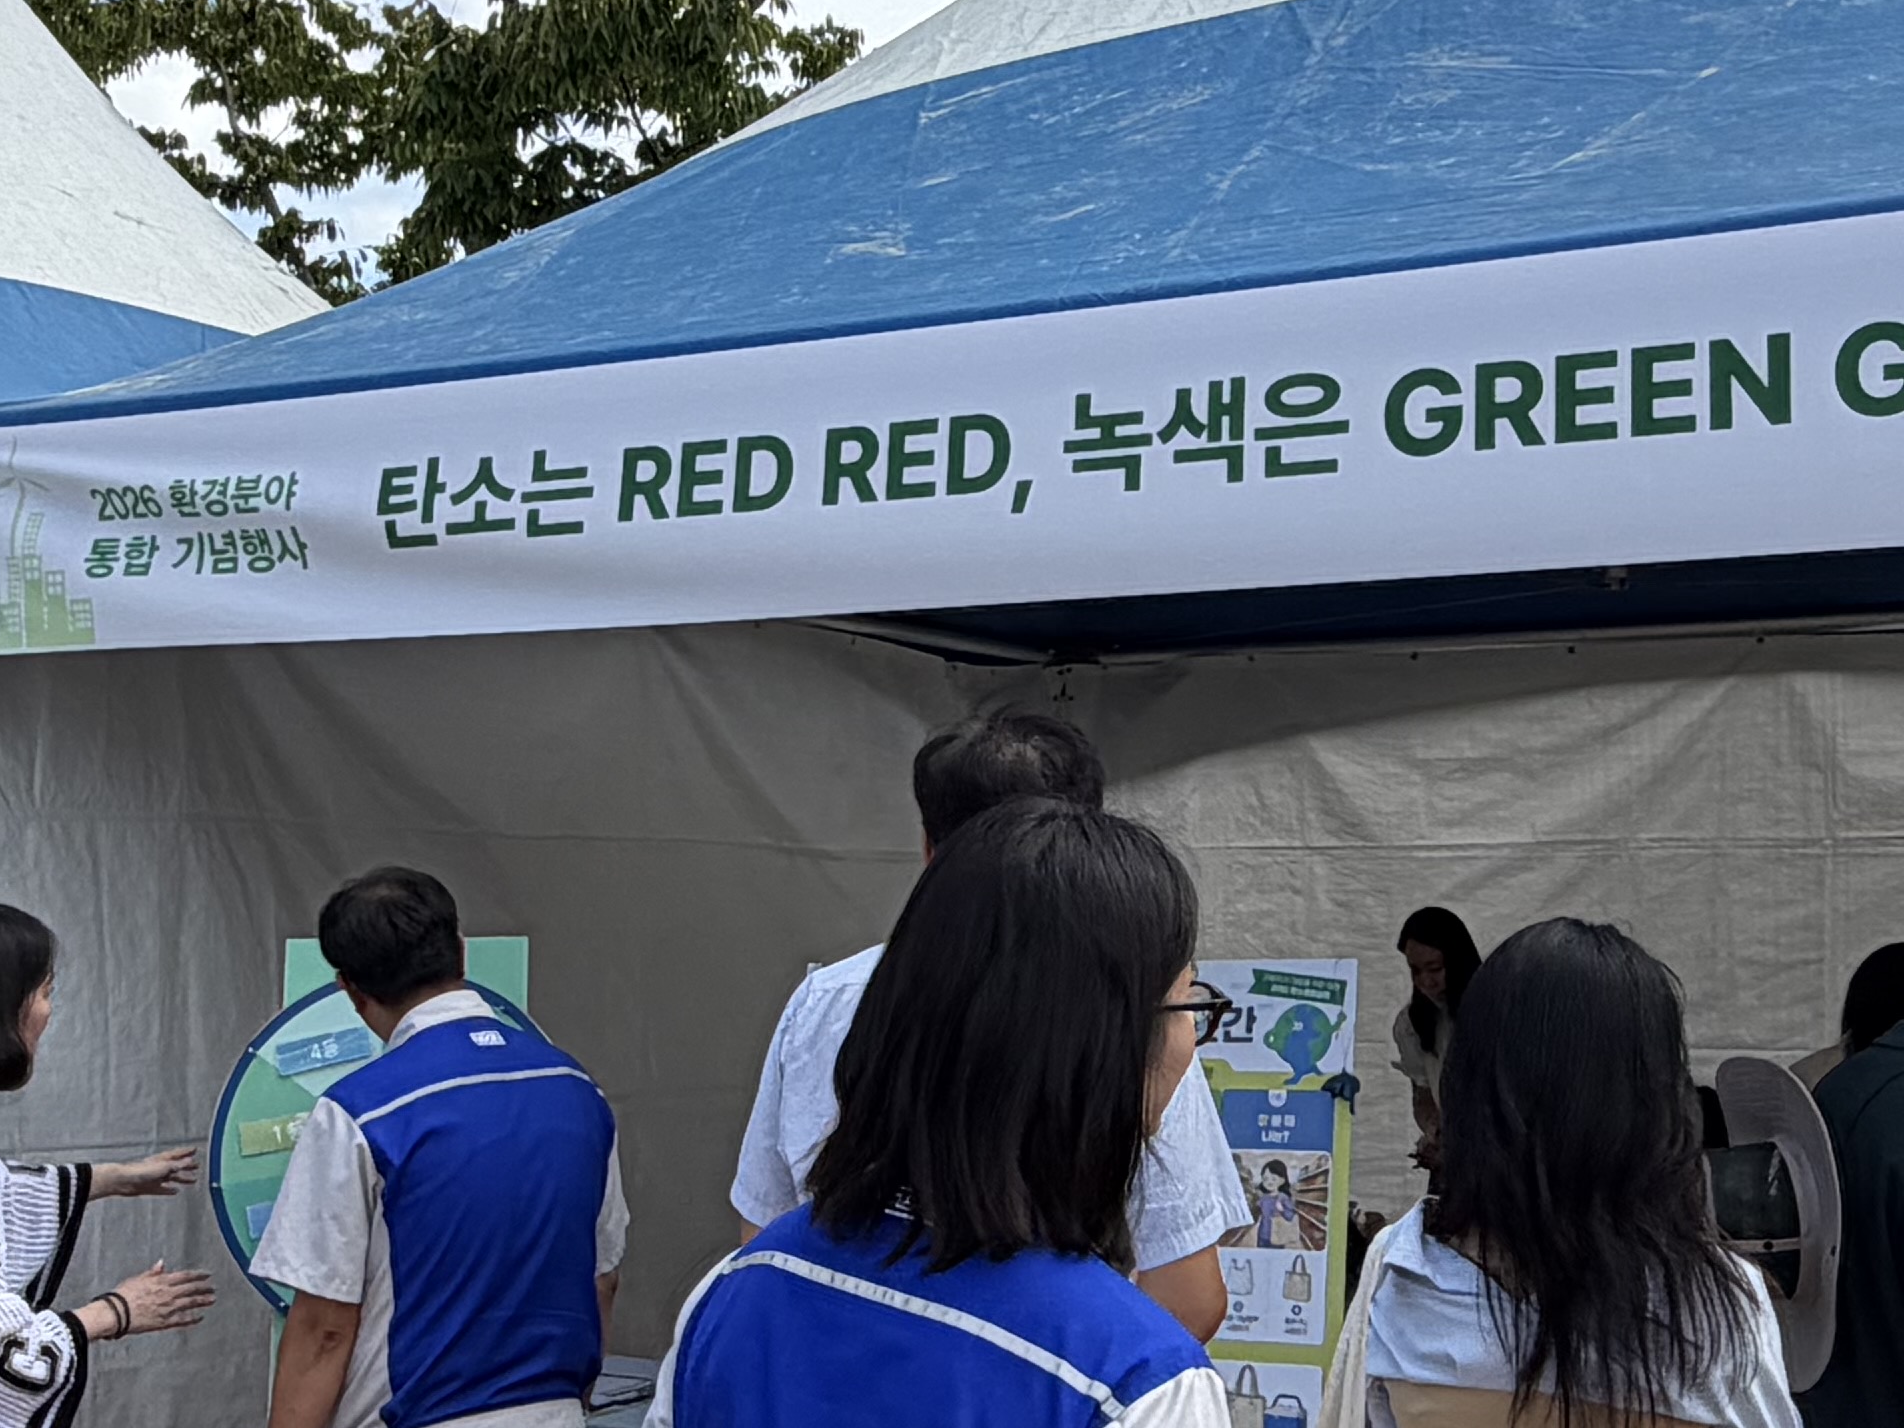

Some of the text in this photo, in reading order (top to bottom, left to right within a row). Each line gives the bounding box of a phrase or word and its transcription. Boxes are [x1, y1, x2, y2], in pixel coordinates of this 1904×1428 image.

[377, 450, 593, 549] 탄소는
[618, 435, 793, 522] RED
[822, 414, 1032, 513] RED,
[1063, 373, 1349, 491] 녹색은
[1385, 333, 1791, 456] GREEN
[90, 472, 298, 521] 2026 환경분야
[84, 526, 309, 578] 통합 기념행사
